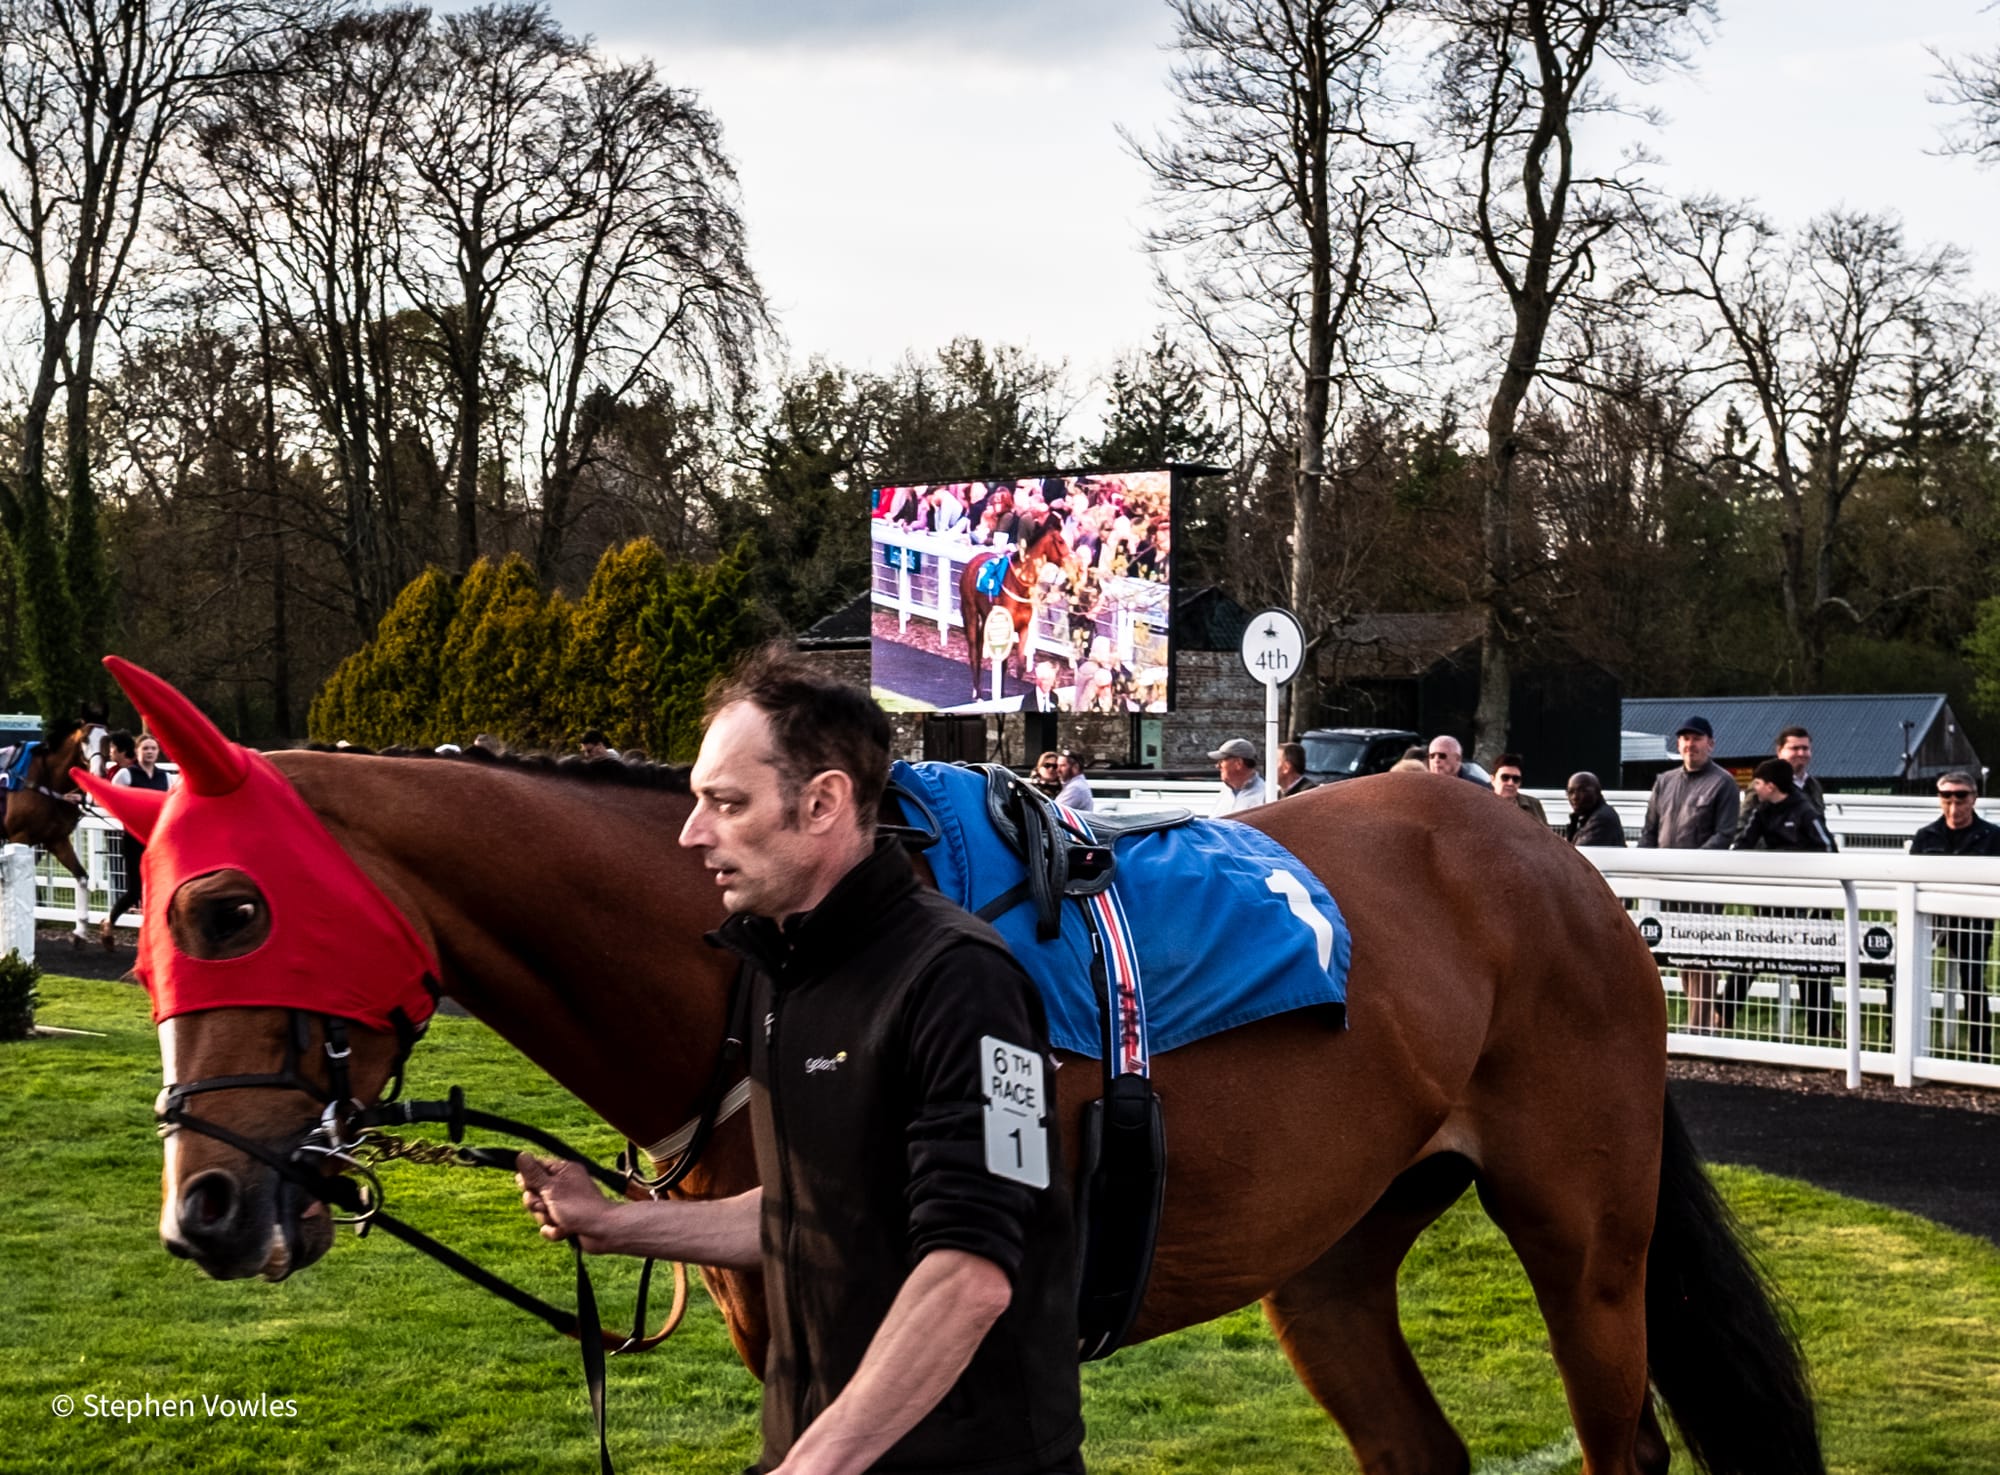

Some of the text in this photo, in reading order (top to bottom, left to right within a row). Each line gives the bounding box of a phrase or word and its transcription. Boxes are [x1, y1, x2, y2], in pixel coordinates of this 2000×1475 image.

[1255, 648, 1288, 669] 4th
[1265, 868, 1333, 972] 1
[1671, 926, 1837, 946] European Breeders' Fund
[1668, 956, 1708, 968] Supporting
[992, 1076, 1036, 1108] RACE
[1008, 1128, 1022, 1168] 1
